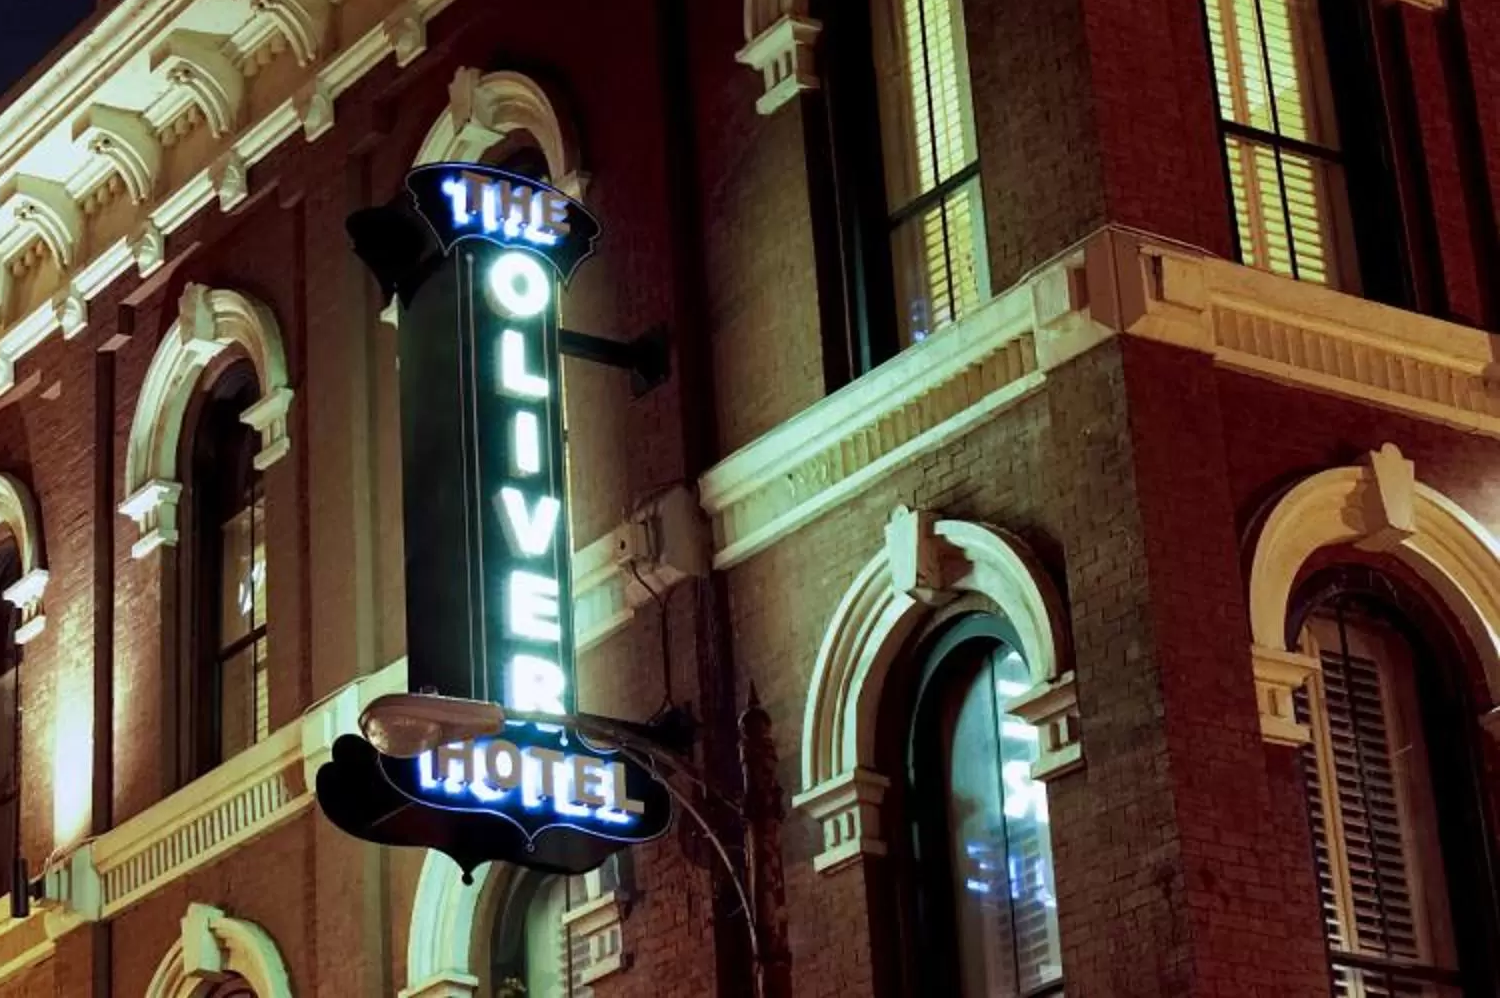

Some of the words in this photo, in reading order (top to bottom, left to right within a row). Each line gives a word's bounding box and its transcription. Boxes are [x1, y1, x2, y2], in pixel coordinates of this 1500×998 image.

[443, 170, 571, 245] THE
[487, 252, 566, 731] OLIVER
[420, 739, 645, 822] HOTEL
